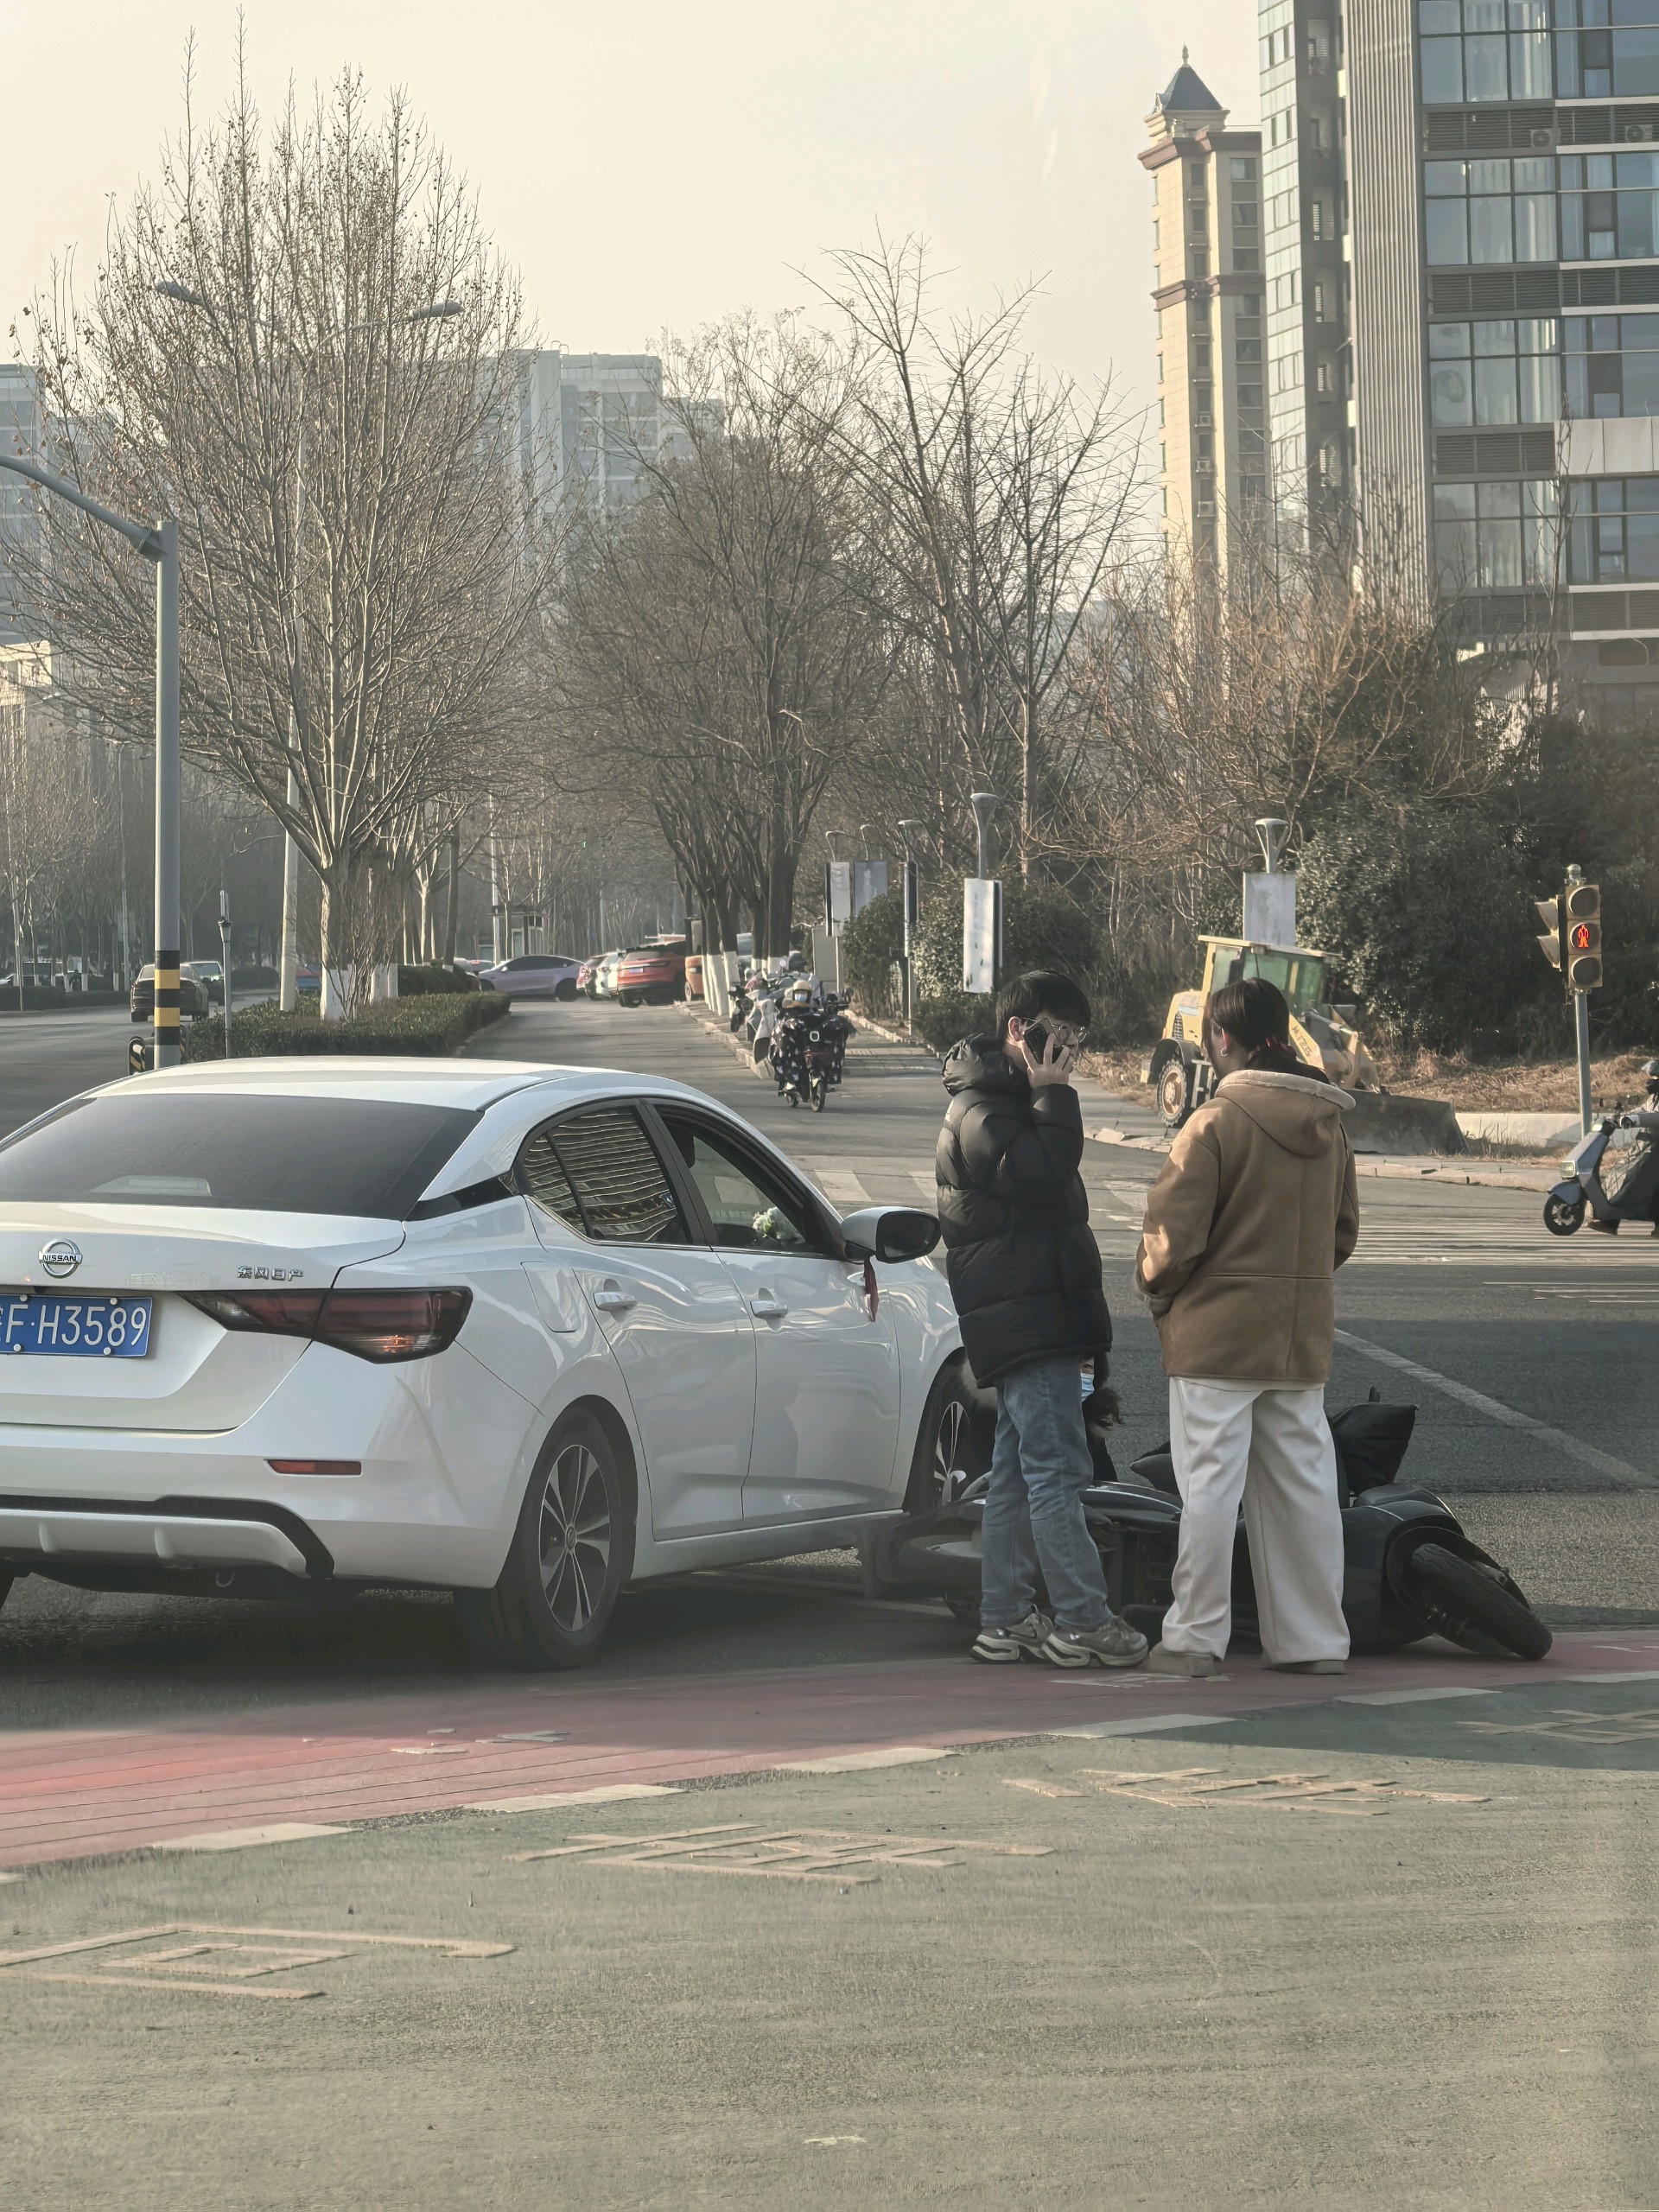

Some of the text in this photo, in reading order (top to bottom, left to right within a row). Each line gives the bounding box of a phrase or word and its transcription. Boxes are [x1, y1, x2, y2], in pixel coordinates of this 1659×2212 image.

[237, 1266, 304, 1281] 东风日产
[0, 1303, 147, 1346] F·H3589
